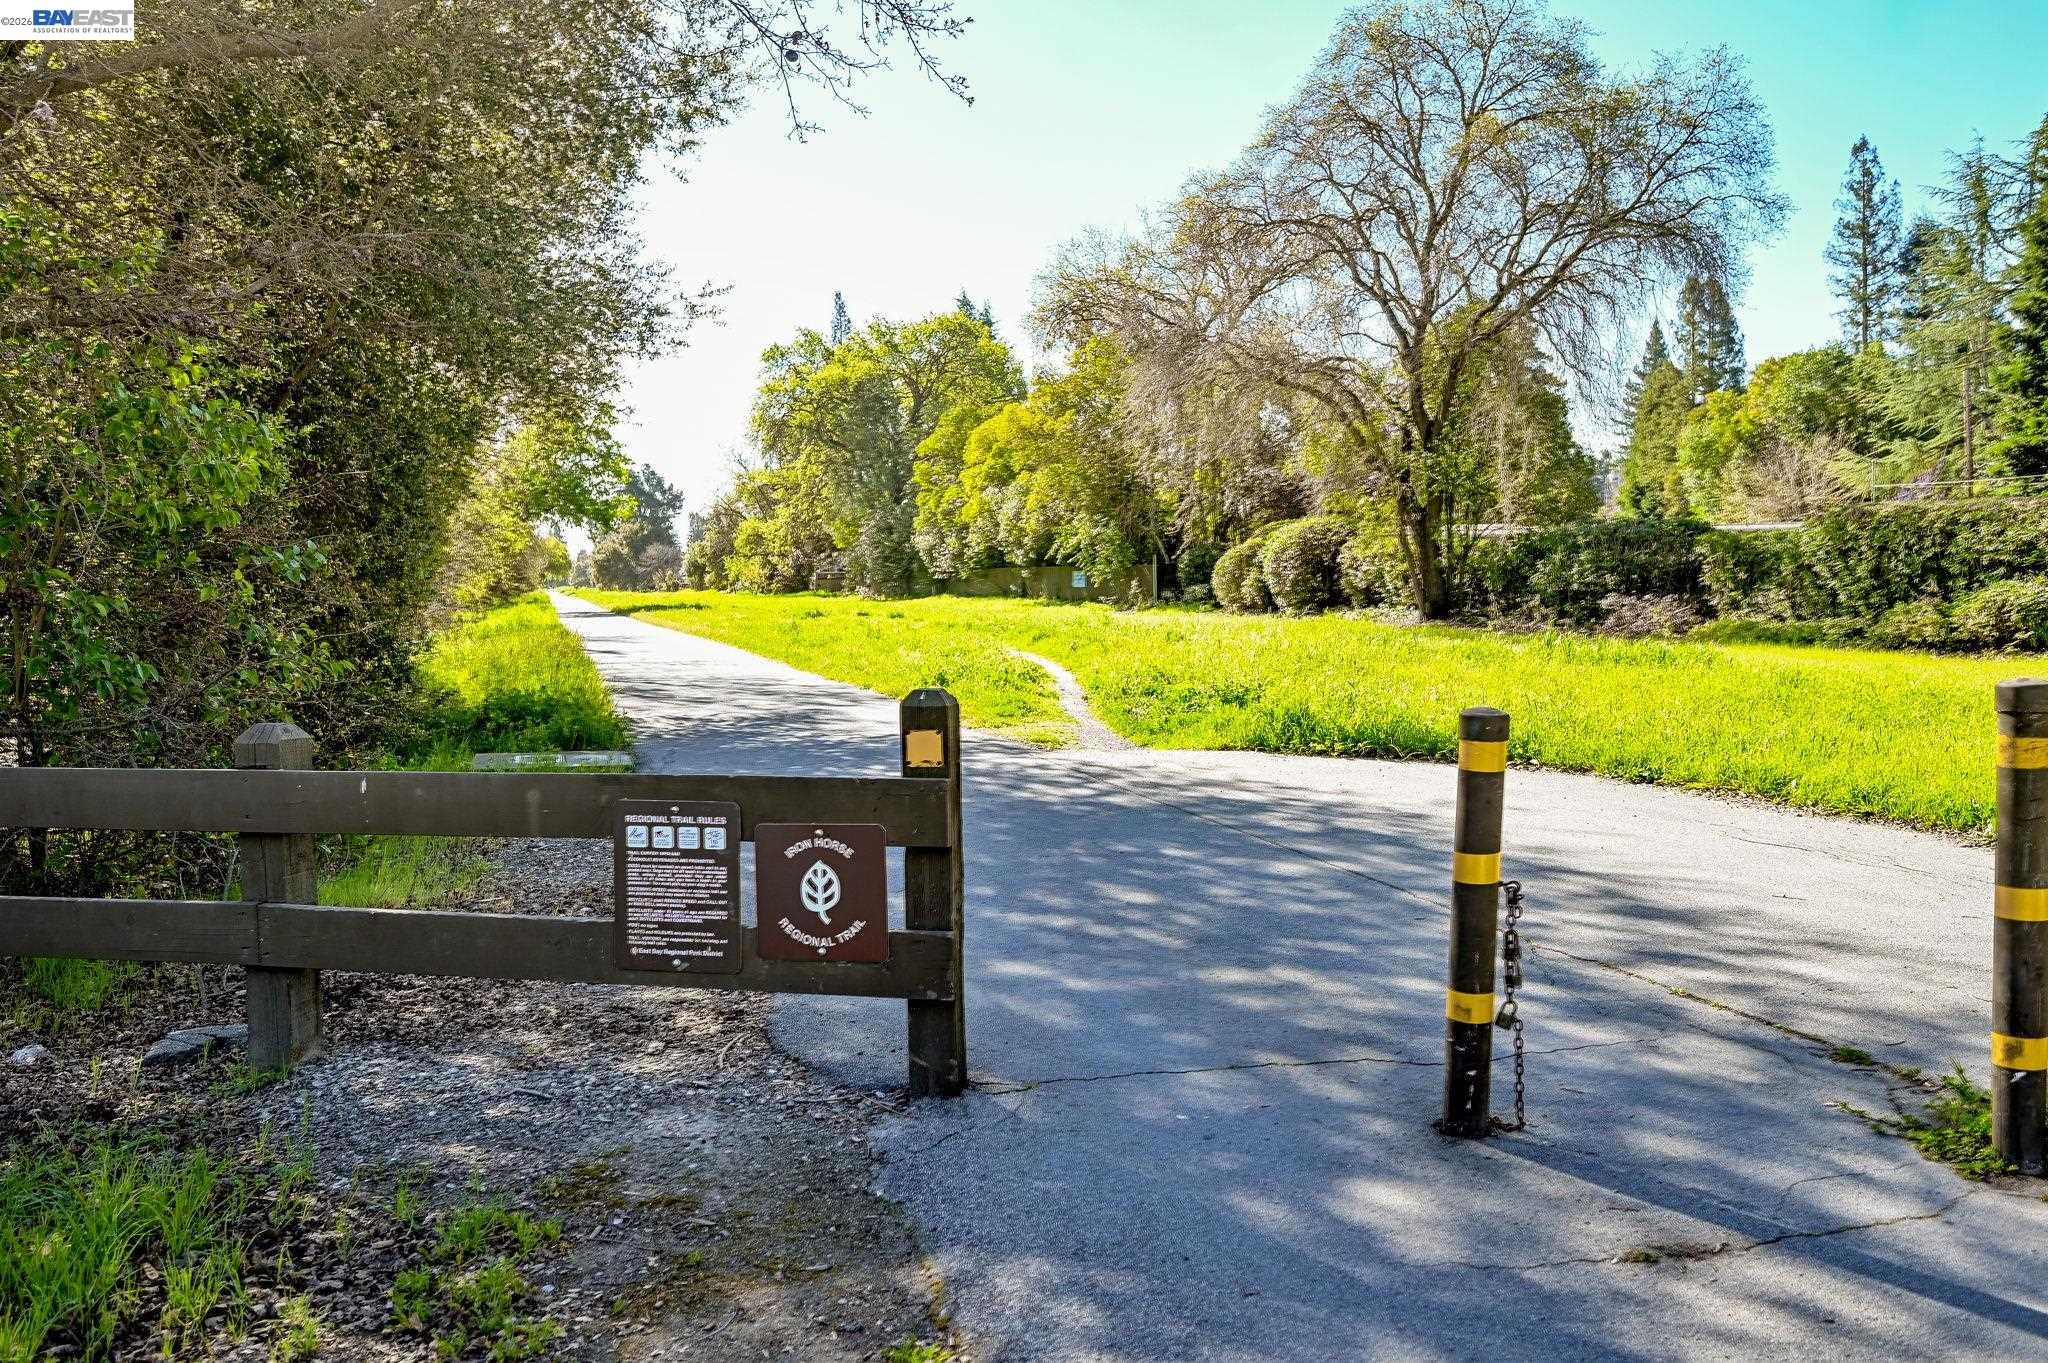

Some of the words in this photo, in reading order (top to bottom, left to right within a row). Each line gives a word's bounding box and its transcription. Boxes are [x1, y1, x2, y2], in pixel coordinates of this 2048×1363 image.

[624, 815, 670, 823] REGIONAL
[670, 815, 697, 824] TRAIL
[697, 816, 728, 825] RULES
[784, 838, 813, 859] IRON
[813, 837, 855, 859] HORSE
[777, 916, 837, 947] REGIONAL
[834, 919, 867, 944] TRAIL
[664, 948, 688, 956] Regional
